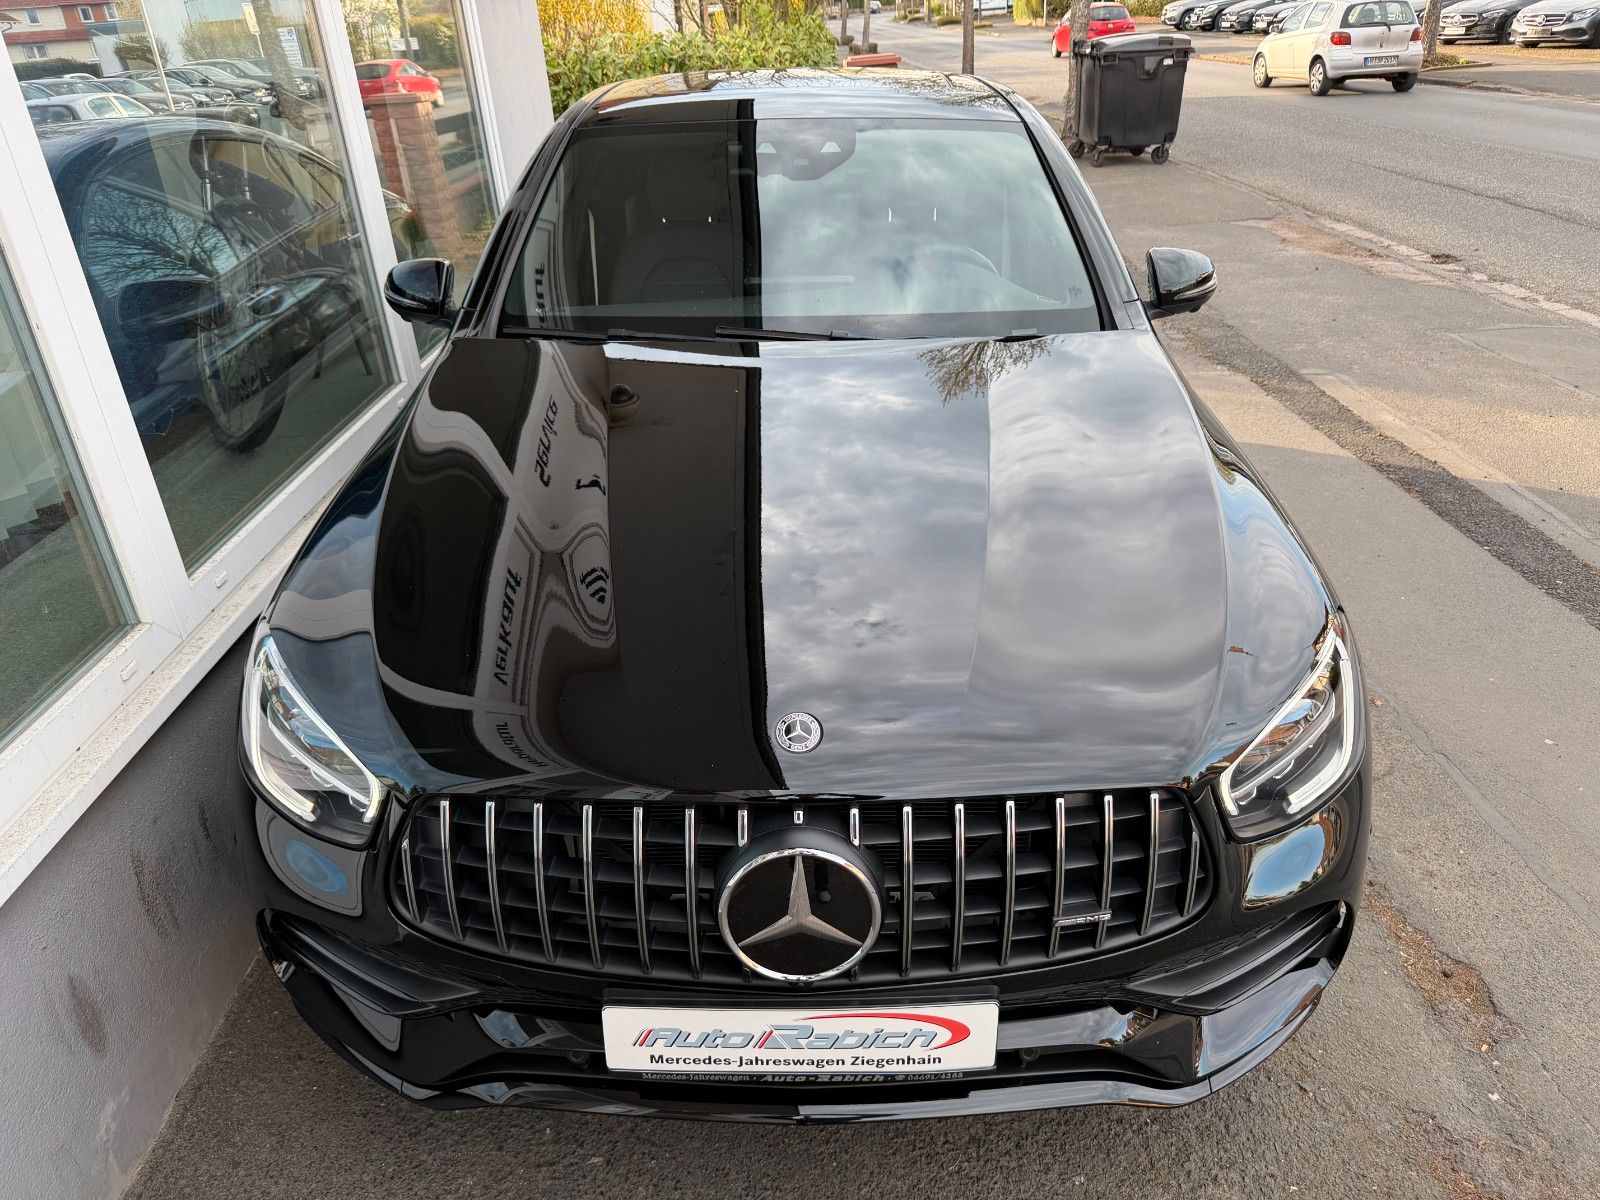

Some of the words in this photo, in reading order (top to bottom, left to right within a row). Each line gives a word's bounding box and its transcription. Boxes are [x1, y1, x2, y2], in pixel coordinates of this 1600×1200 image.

[643, 1027, 755, 1049] Auto
[764, 1024, 938, 1050] Rabich
[649, 1054, 846, 1069] Mercedes-Jahreswagen
[850, 1054, 942, 1069] Ziegenhain
